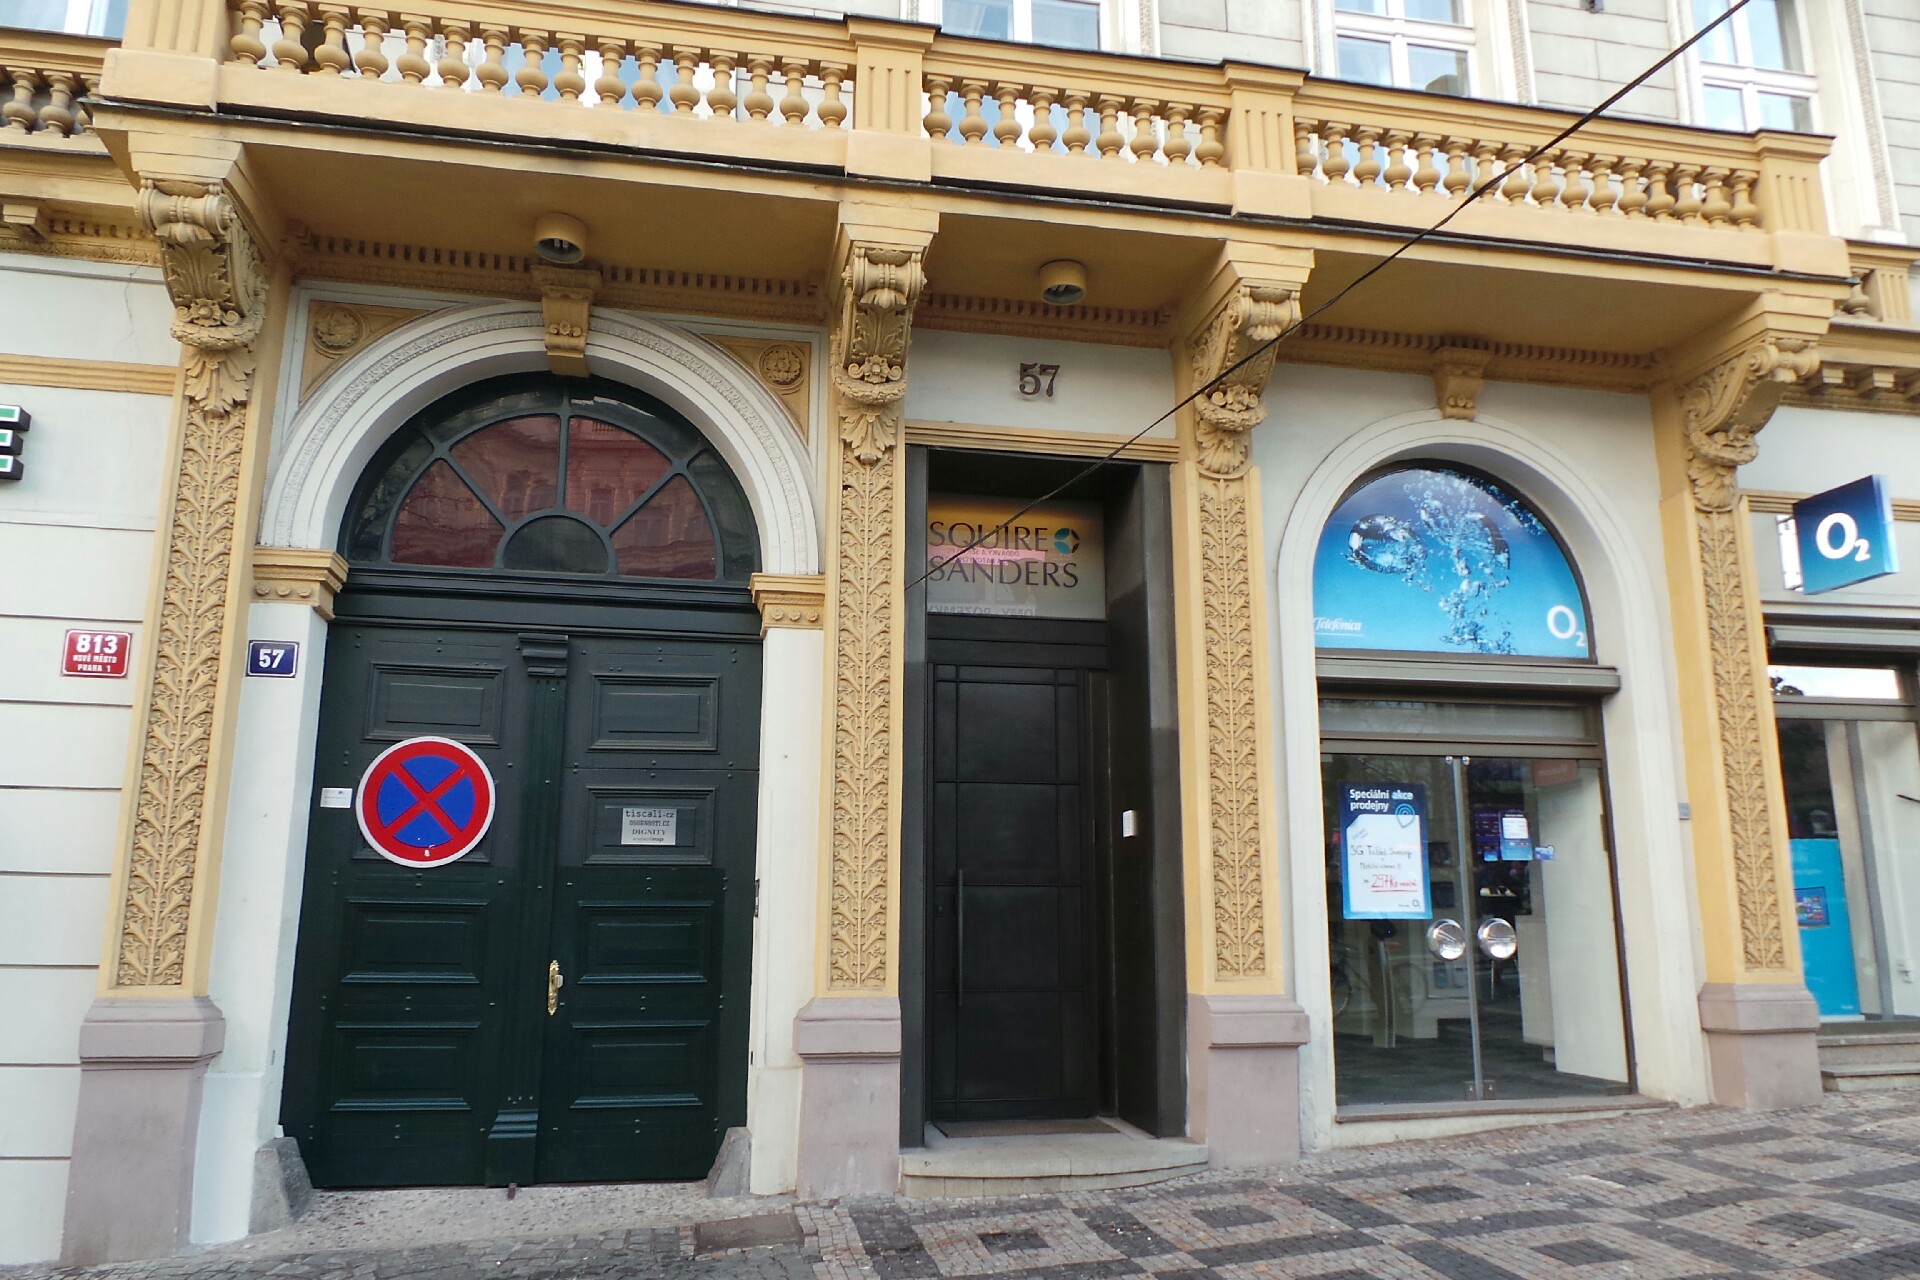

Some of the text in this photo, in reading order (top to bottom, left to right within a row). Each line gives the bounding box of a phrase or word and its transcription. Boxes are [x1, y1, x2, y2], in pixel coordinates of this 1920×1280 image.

[1019, 362, 1060, 397] 57
[929, 521, 1048, 552] SQUIRE
[1816, 512, 1871, 561] O2
[929, 556, 1079, 588] SANDERS
[1547, 604, 1585, 647] O2
[76, 634, 118, 654] 813
[73, 653, 118, 664] NOVÉ MĚSTO
[77, 663, 111, 672] PRAHA 1
[259, 648, 285, 669] 57
[1349, 789, 1414, 800] Speciální akce
[625, 809, 674, 818] tiscali.cz
[1350, 800, 1389, 812] prodejny
